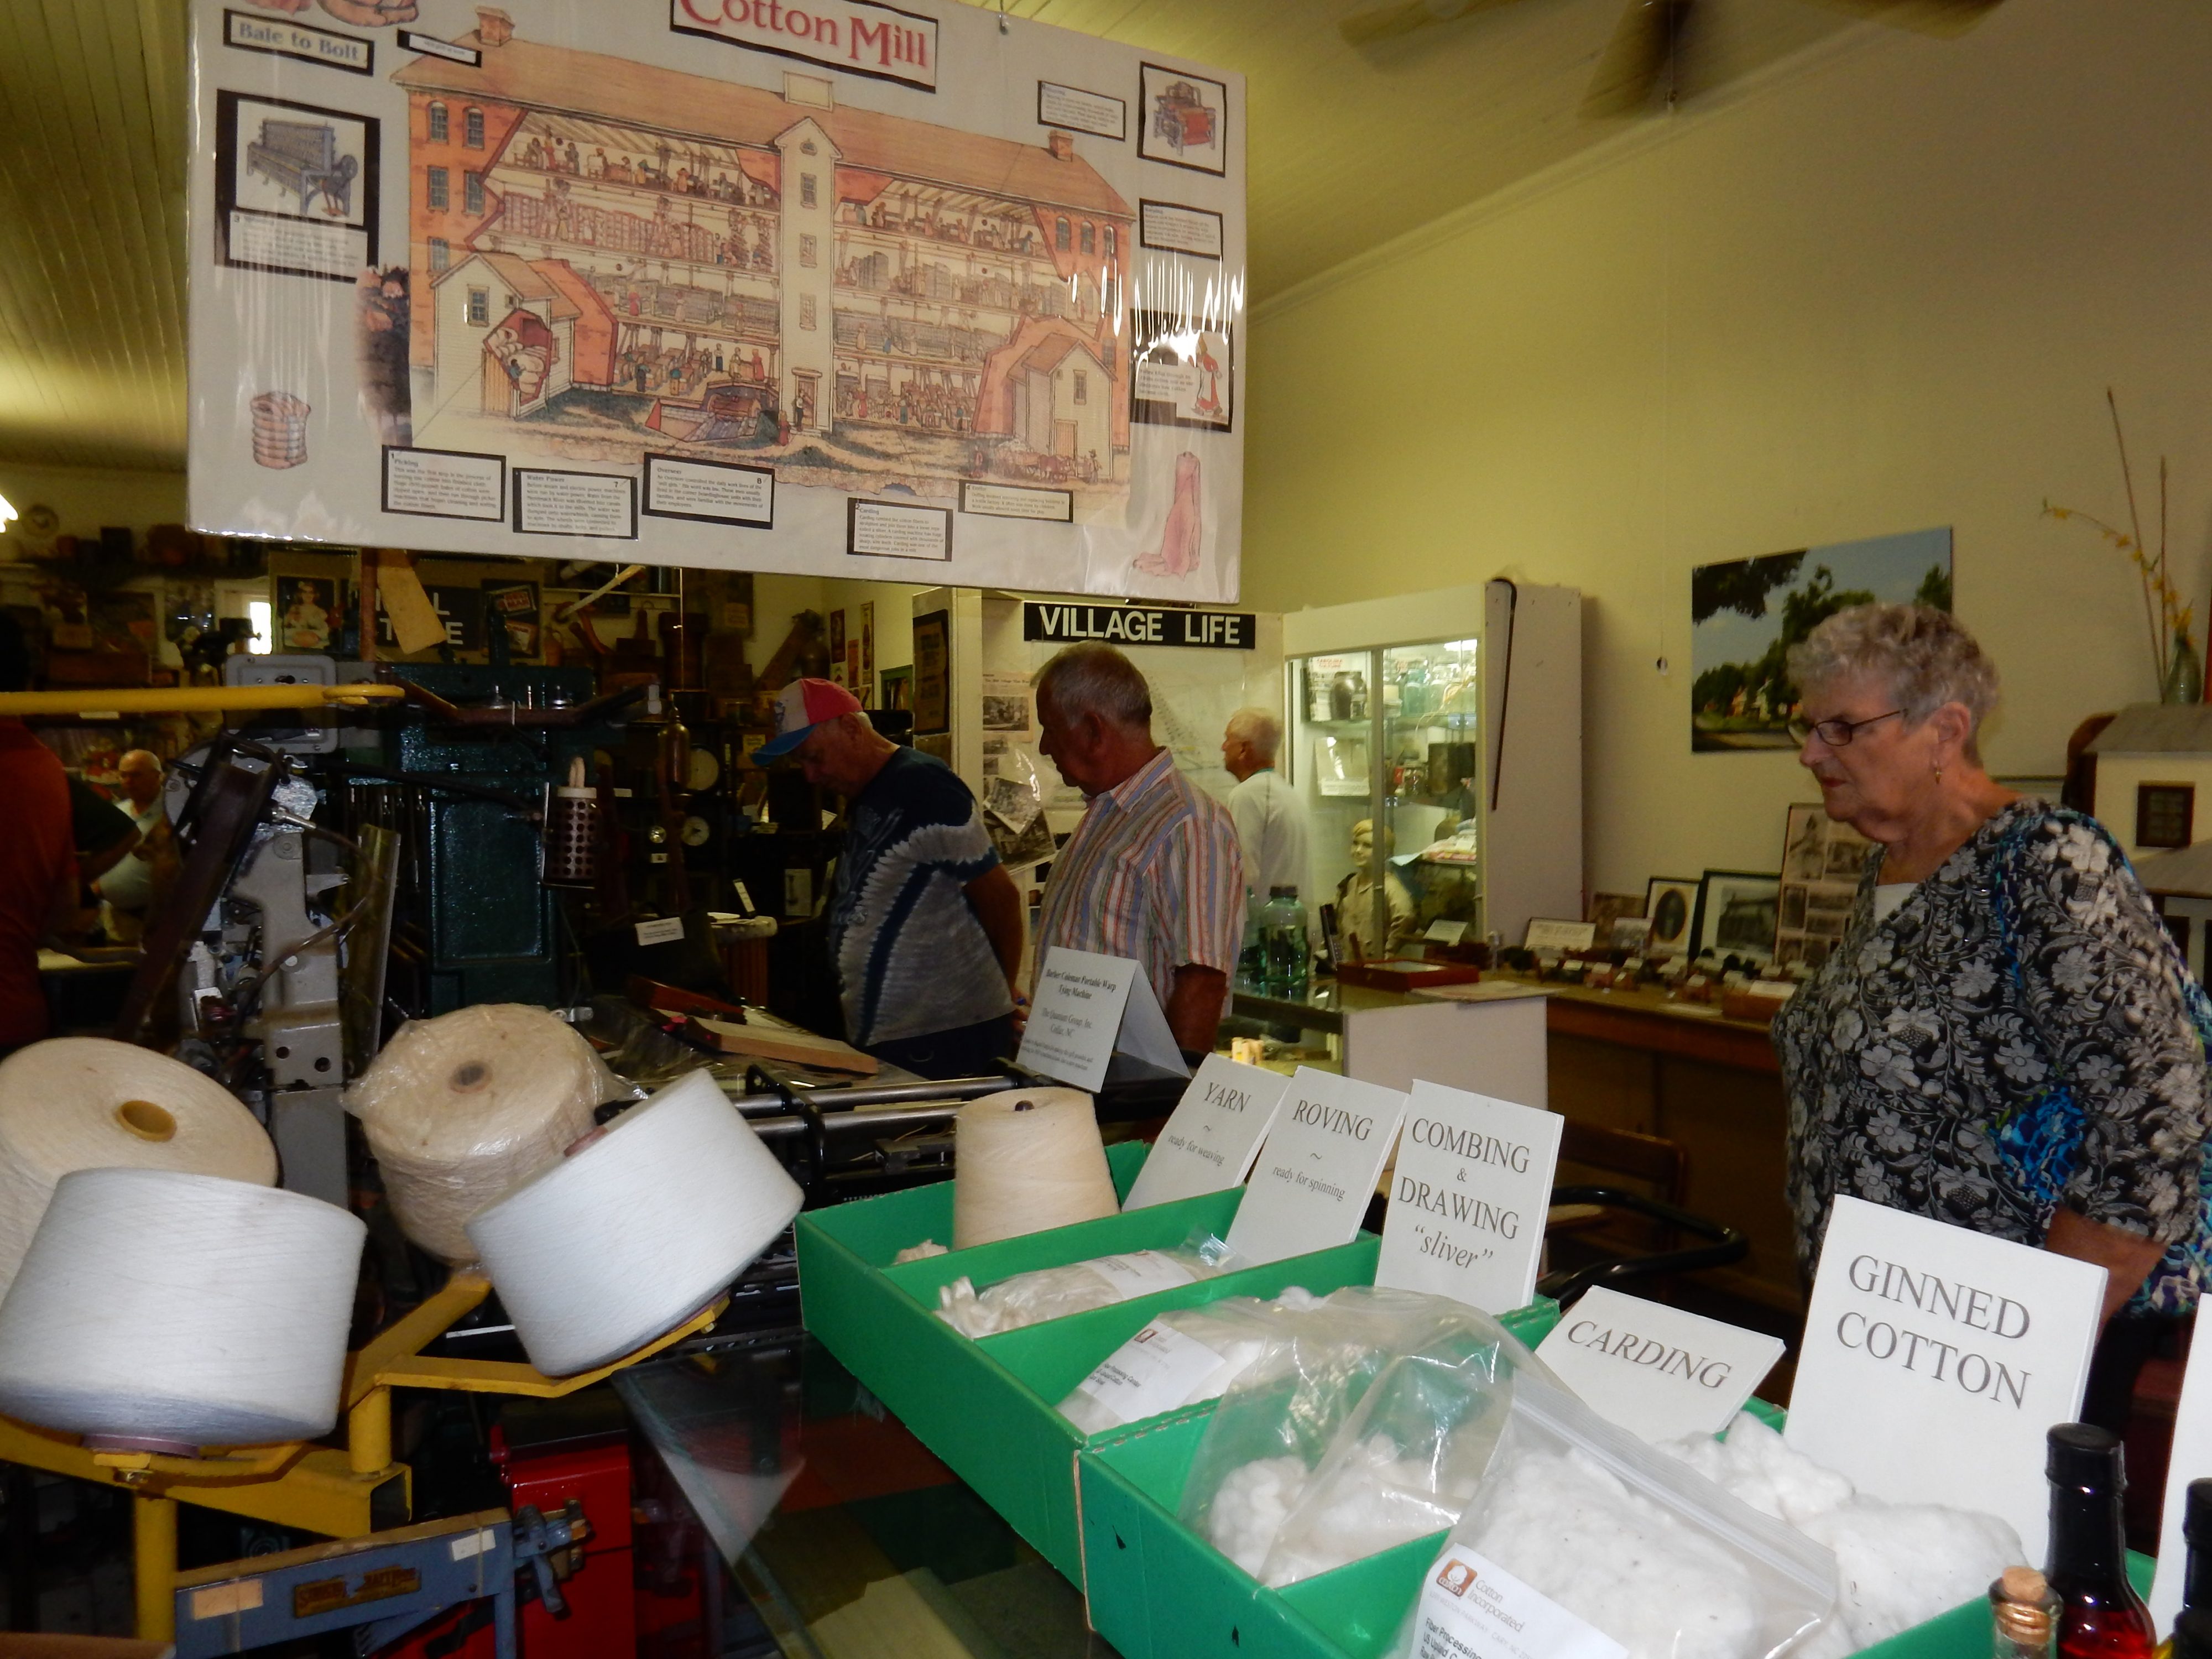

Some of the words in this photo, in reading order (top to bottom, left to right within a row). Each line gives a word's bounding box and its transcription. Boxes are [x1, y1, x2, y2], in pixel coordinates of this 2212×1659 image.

[239, 23, 283, 43] Bale
[291, 32, 311, 49] to
[319, 39, 358, 61] Bolt
[849, 17, 926, 67] Mill
[1039, 606, 1163, 641] VILLAGE
[1185, 613, 1240, 644] LIFE
[1072, 987, 1092, 999] Machine
[1102, 979, 1117, 993] Warp
[1204, 1082, 1250, 1112] YARN
[1292, 1100, 1373, 1140] ROVING
[1168, 1135, 1185, 1151] ready
[1187, 1141, 1198, 1152] for
[1198, 1147, 1224, 1166] weaving
[1413, 1119, 1529, 1173] COMBING
[1273, 1167, 1292, 1183] ready
[1296, 1172, 1308, 1185] for
[1308, 1179, 1345, 1202] spinning
[1457, 1168, 1466, 1182] &
[1399, 1177, 1518, 1239] DRAWING
[1849, 1255, 2030, 1338] GINNED
[1567, 1319, 1731, 1389] CARDING
[1837, 1312, 2031, 1409] COTTON
[1475, 1580, 1503, 1603] Cotton
[1426, 1617, 1439, 1633] Fiber
[1467, 1589, 1526, 1633] Incorporated
